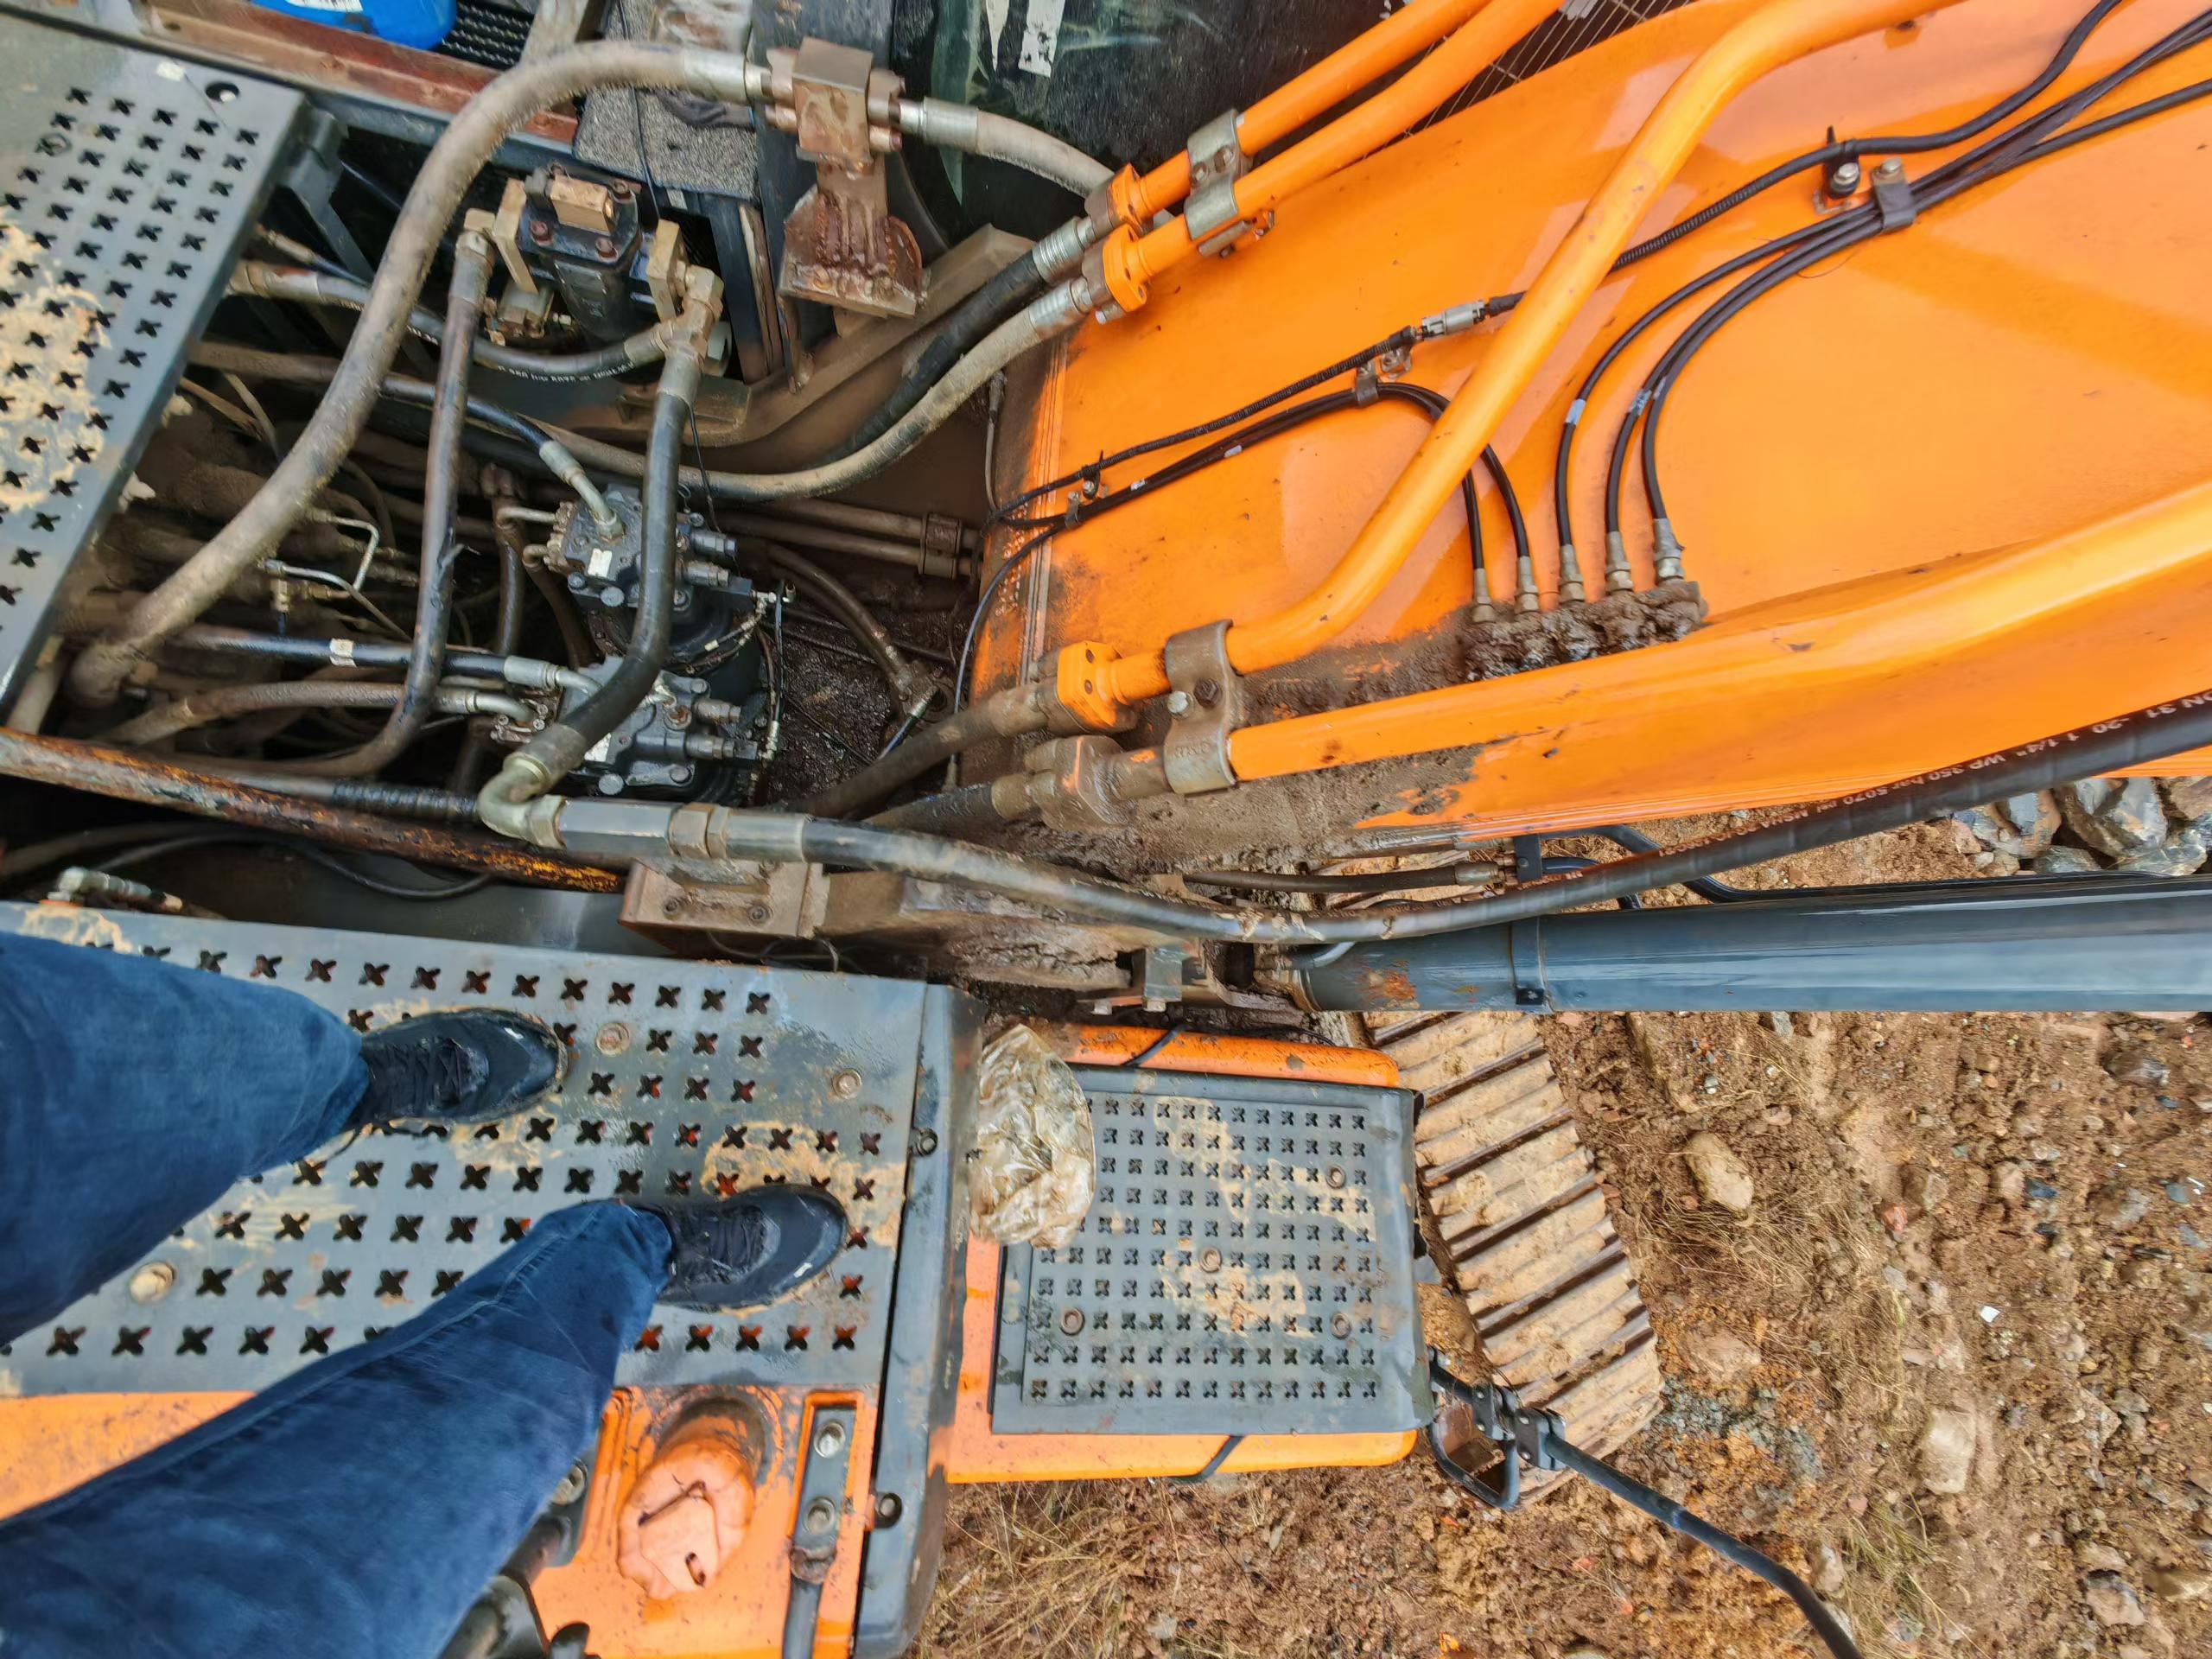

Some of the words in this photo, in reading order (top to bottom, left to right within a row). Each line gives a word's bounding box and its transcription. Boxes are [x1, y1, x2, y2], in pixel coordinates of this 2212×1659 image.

[2146, 703, 2177, 718] 31
[1969, 754, 2005, 769] WP
[1928, 765, 1965, 781] 350
[1891, 776, 1924, 791] bar
[1843, 785, 1888, 804] 5070
